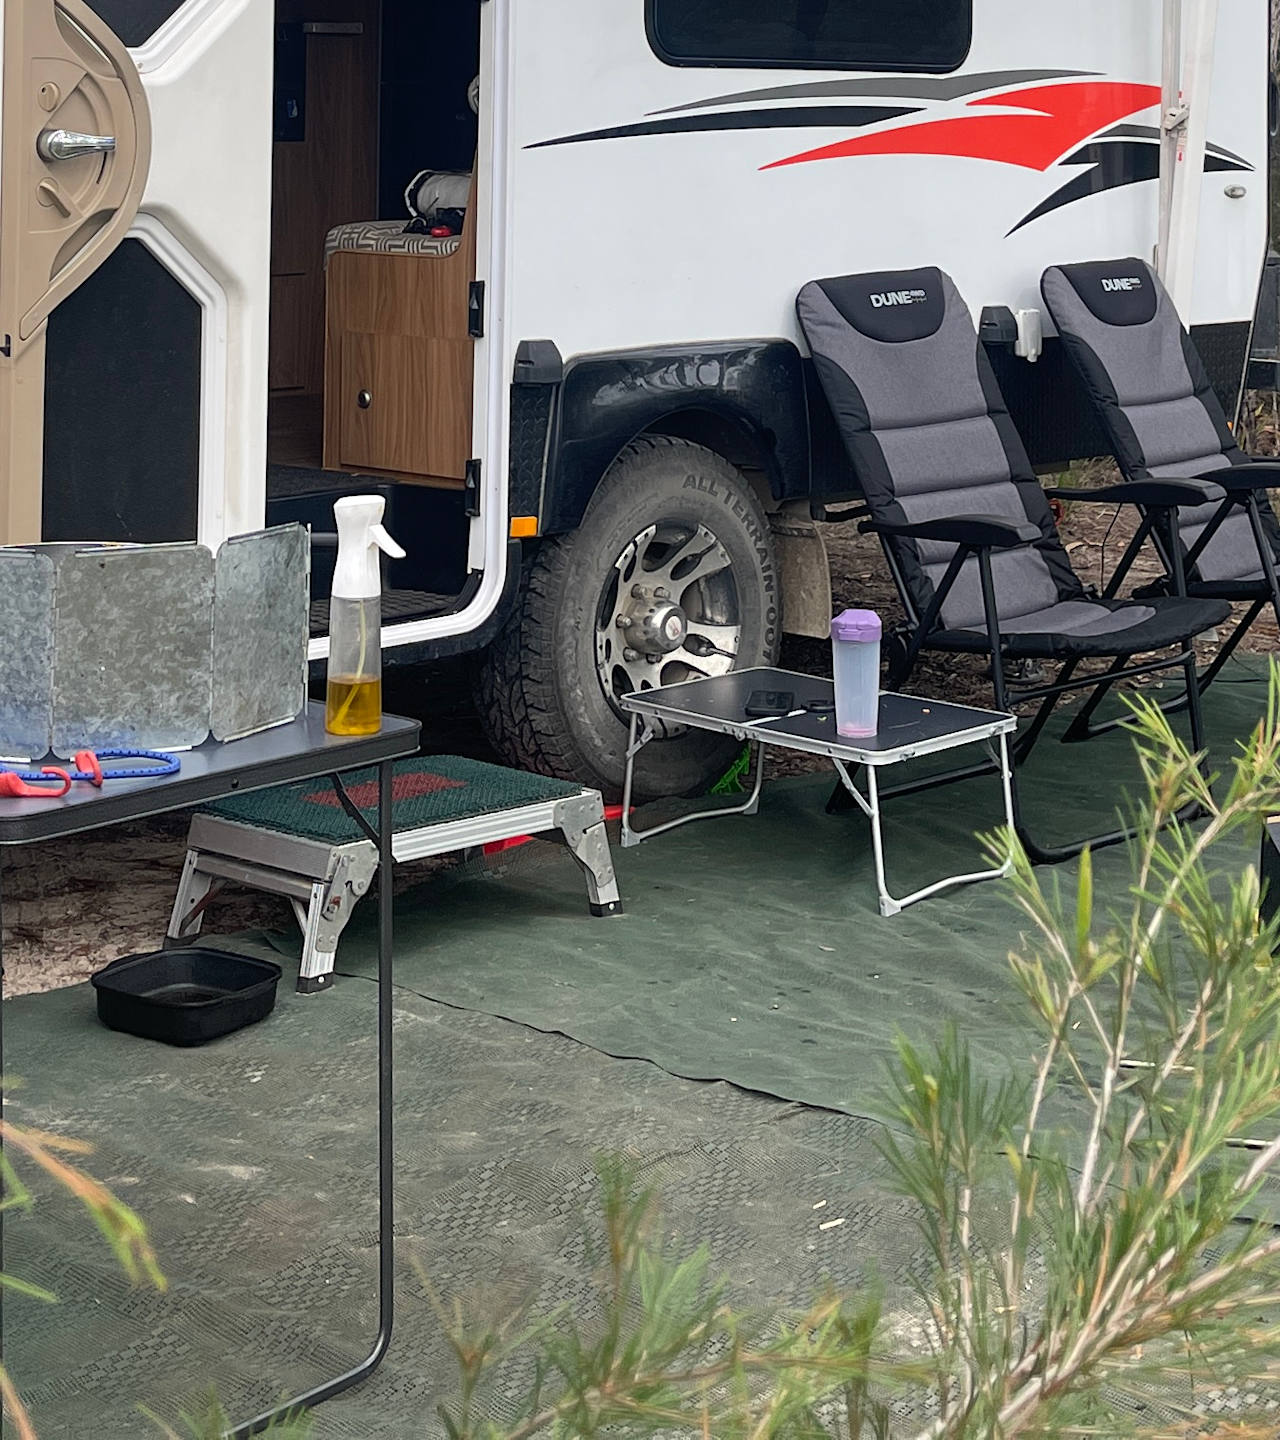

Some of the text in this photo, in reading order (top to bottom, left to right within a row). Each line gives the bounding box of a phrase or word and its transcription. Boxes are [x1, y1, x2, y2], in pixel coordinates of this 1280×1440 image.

[1101, 278, 1133, 291] DUNE
[870, 291, 912, 308] DUNE
[682, 474, 719, 498] ALL
